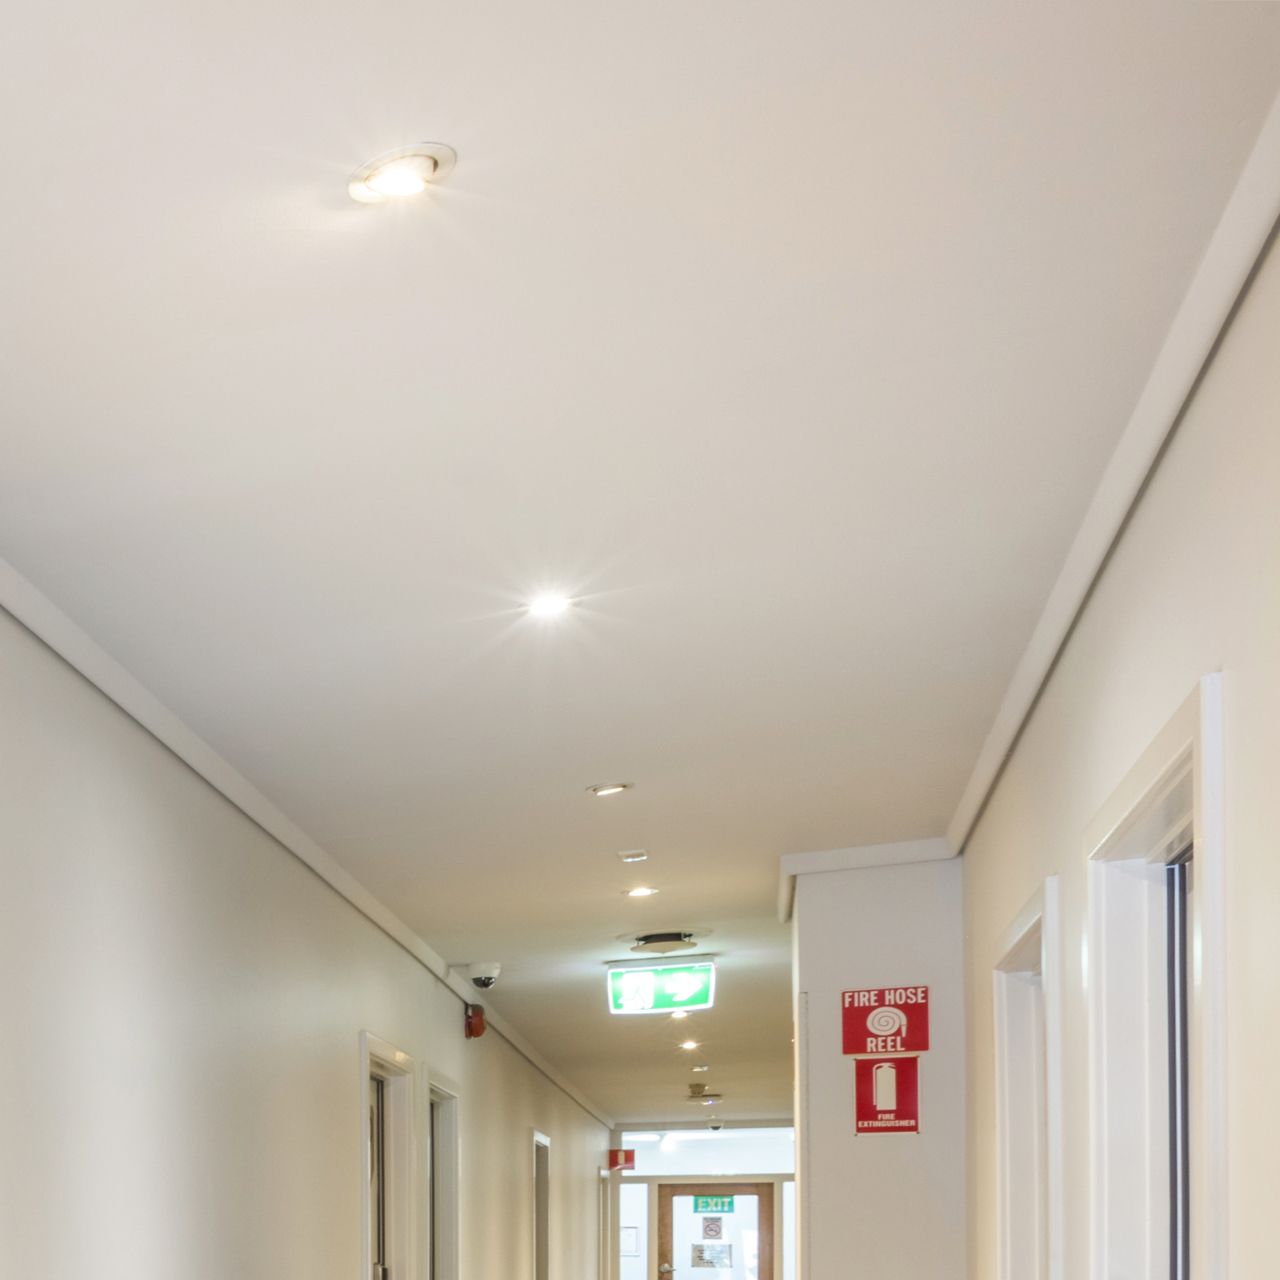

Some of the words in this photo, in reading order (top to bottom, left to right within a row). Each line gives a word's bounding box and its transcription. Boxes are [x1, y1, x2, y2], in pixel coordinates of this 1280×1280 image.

[844, 990, 879, 1008] FIRE
[884, 987, 927, 1006] HOSE
[866, 1036, 906, 1053] REEL
[697, 1198, 732, 1211] EXIT
